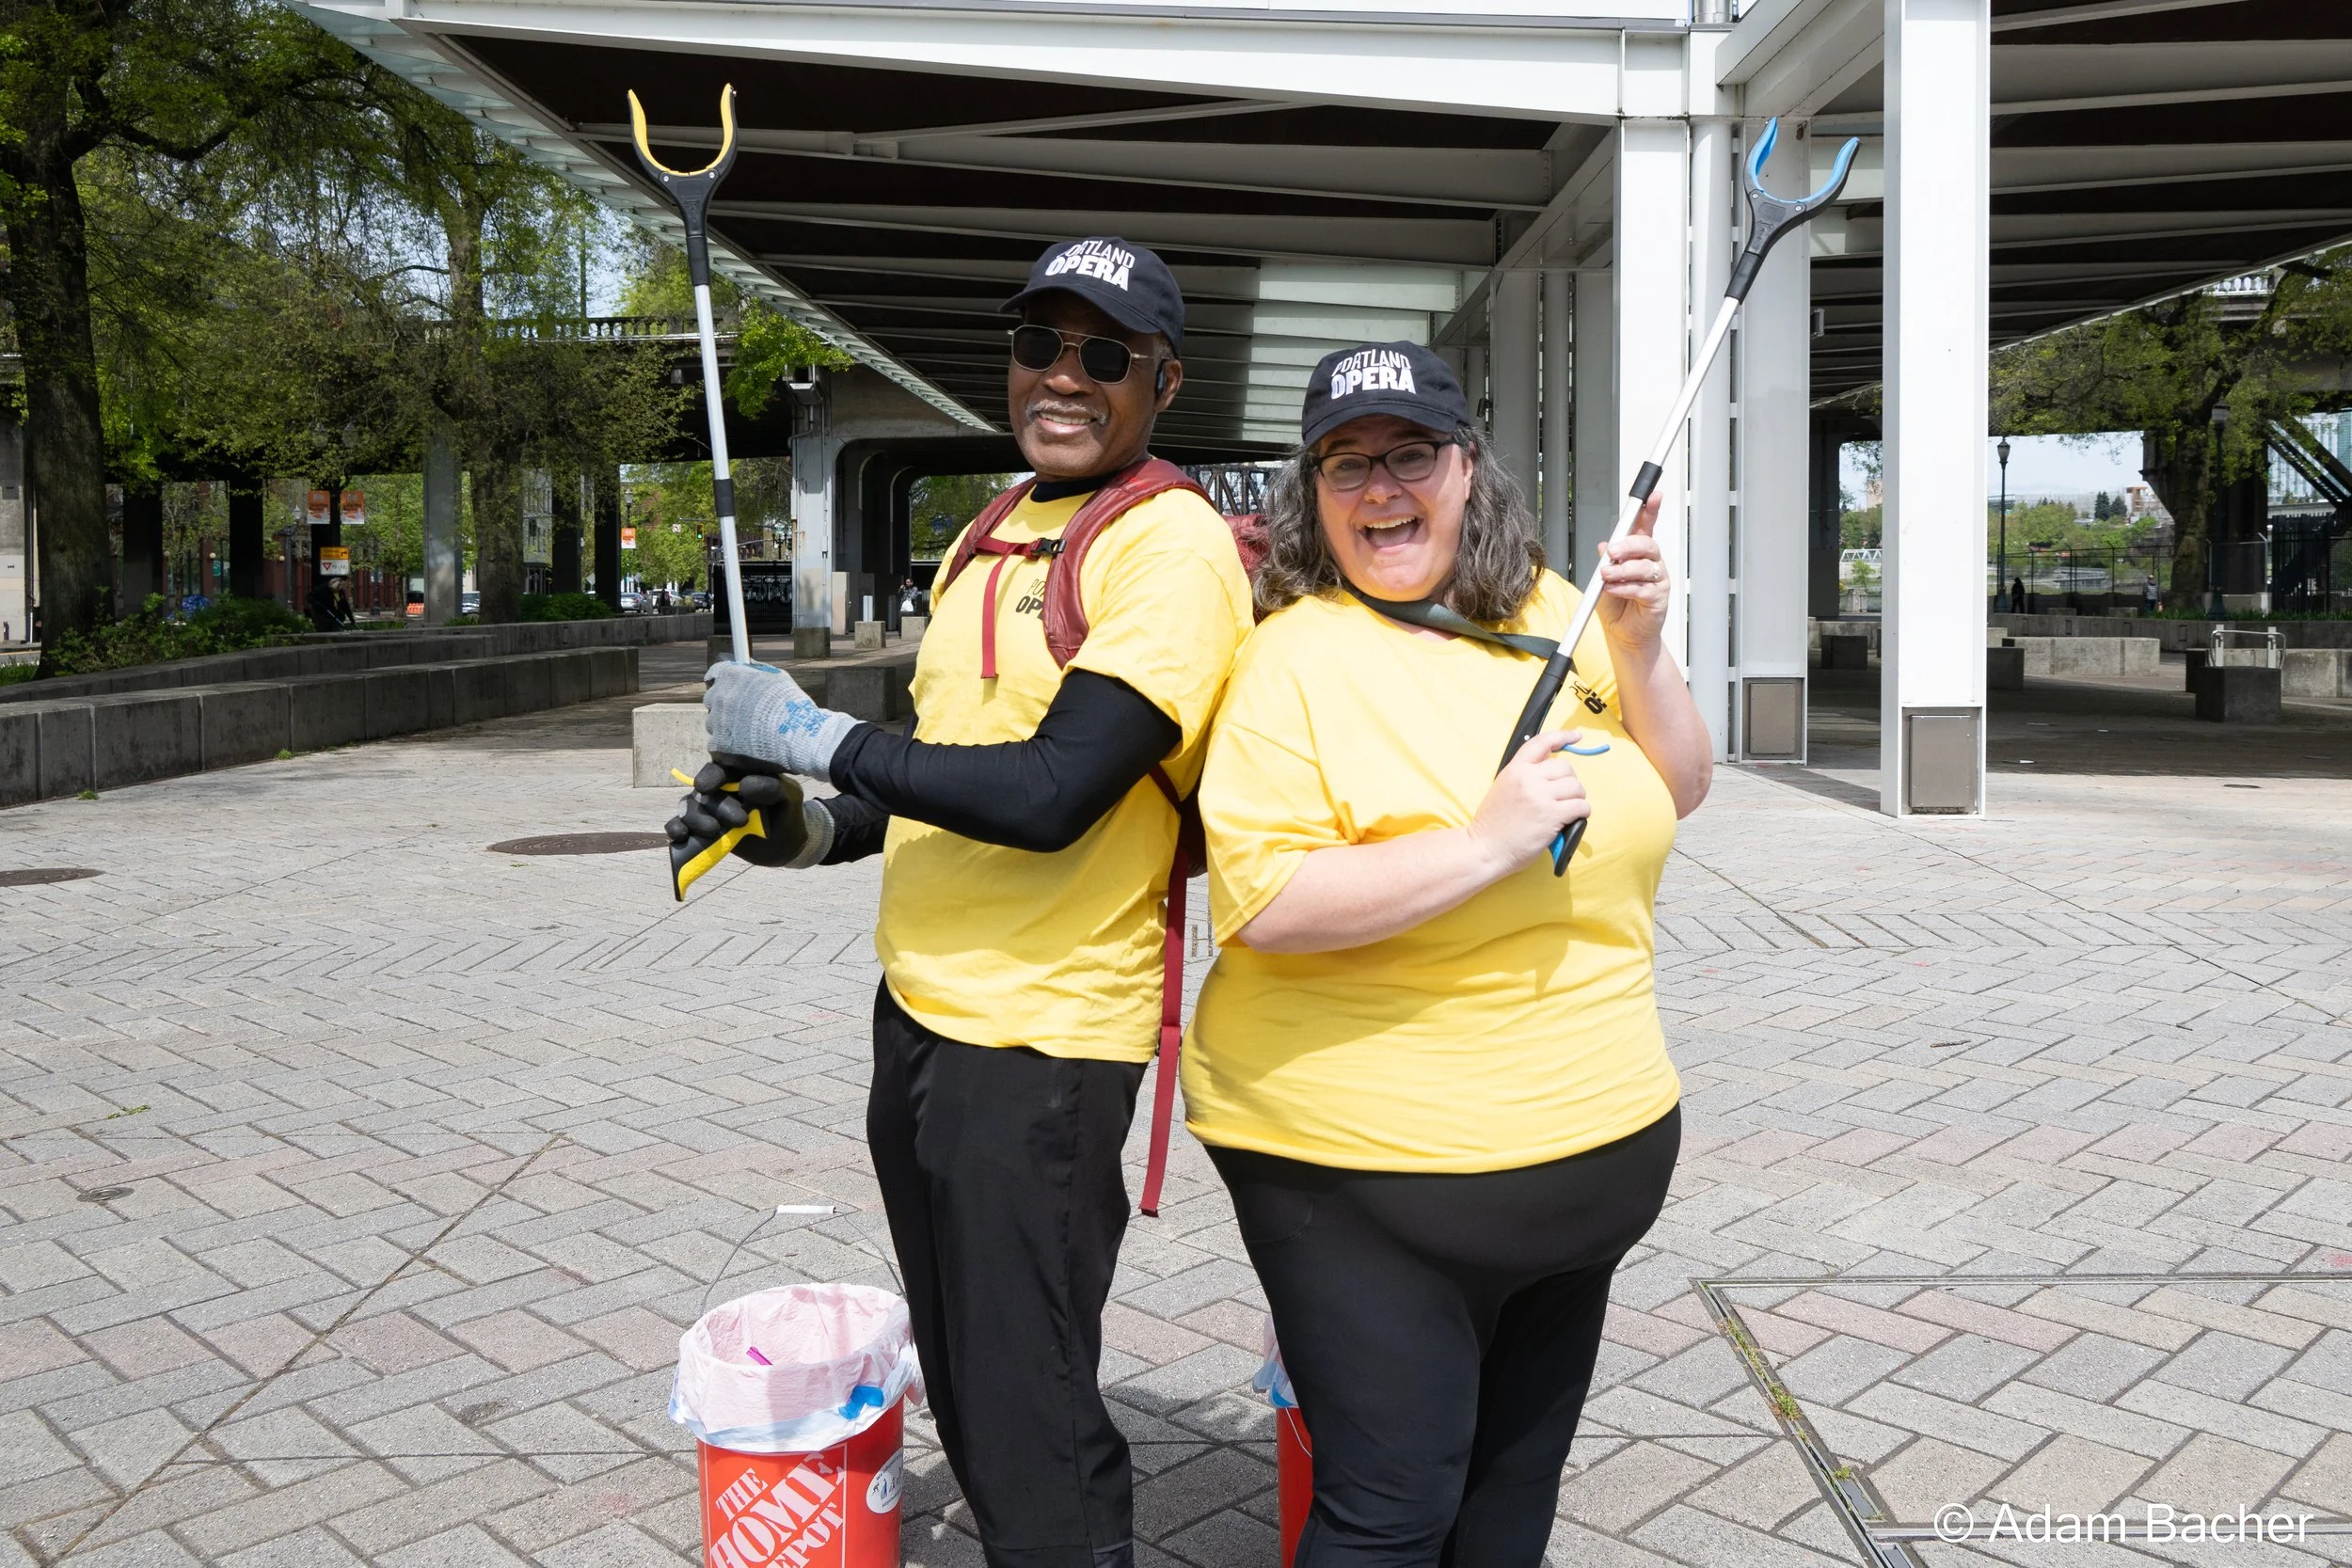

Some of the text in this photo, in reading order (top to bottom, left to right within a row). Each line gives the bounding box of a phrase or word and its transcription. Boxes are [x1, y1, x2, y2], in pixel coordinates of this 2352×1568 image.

[1045, 255, 1129, 292] OPERA
[1331, 349, 1411, 376] PORTLAND
[1331, 366, 1416, 400] OPERA
[710, 1451, 846, 1568] HOME
[715, 1467, 769, 1521] THE
